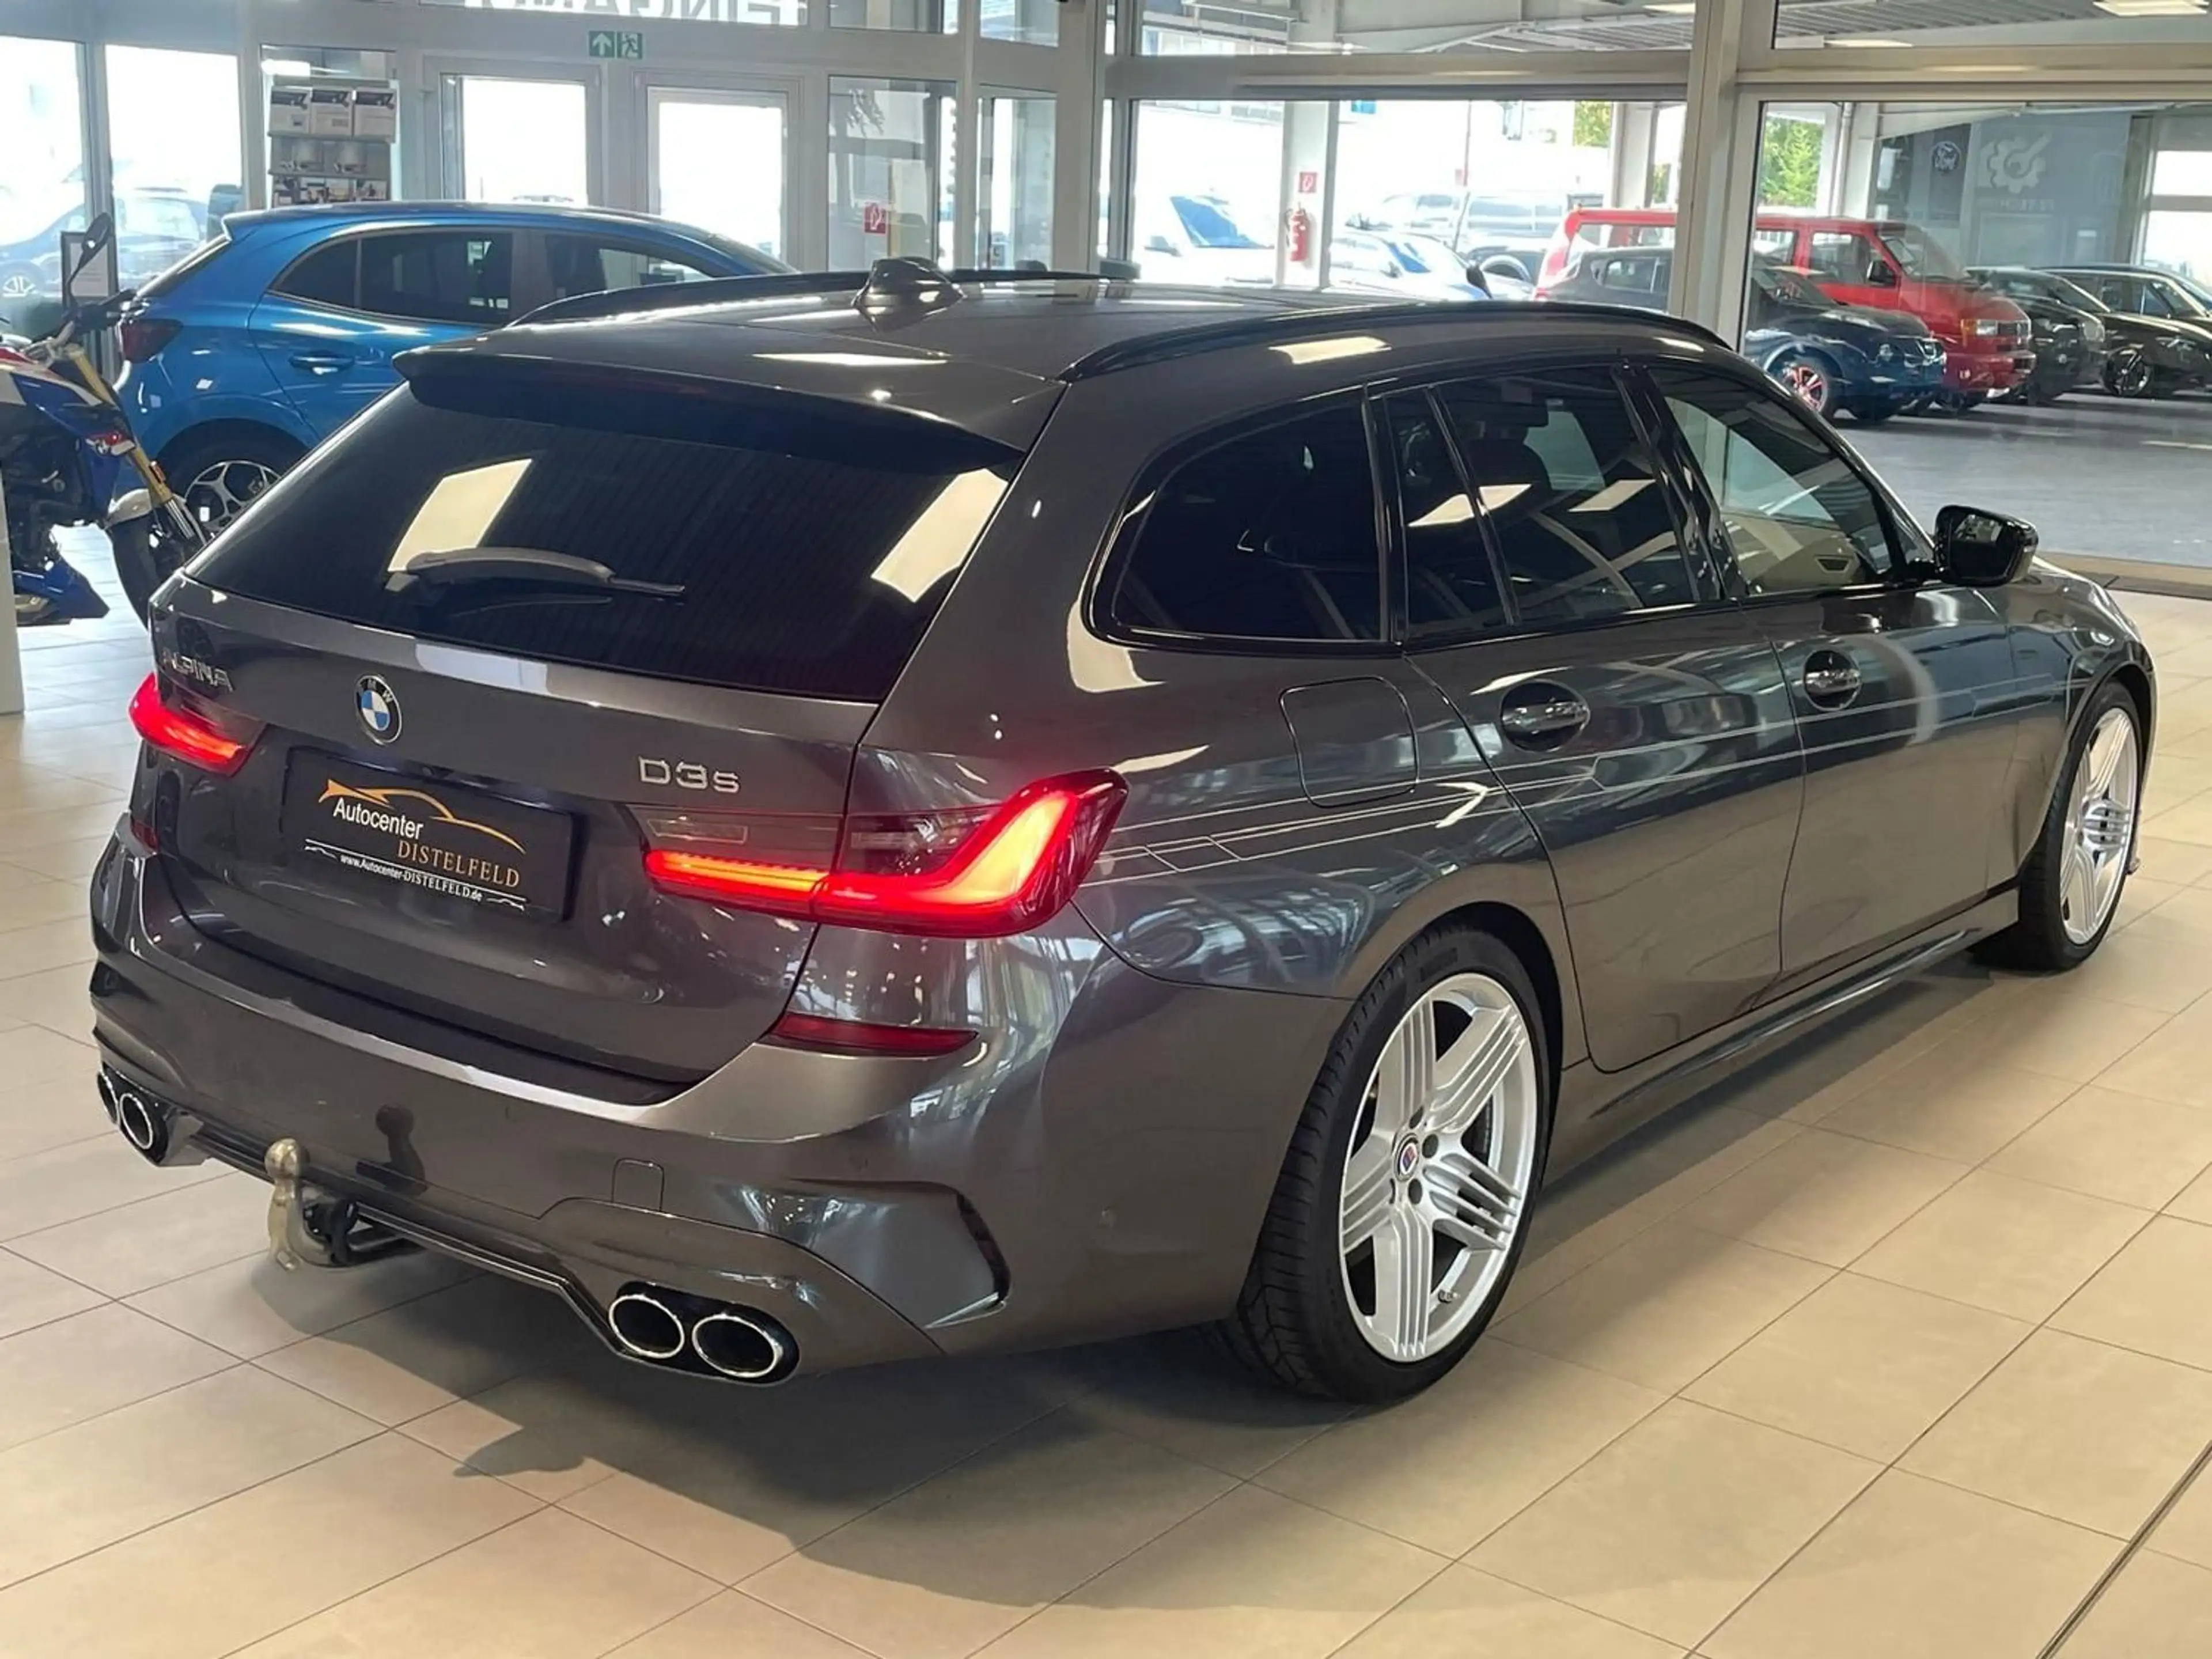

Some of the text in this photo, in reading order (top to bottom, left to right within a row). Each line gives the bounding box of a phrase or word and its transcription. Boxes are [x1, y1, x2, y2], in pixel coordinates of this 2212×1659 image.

[334, 799, 424, 839] Autocenter
[340, 855, 483, 902] www.Autocenter-DISTELFELD.de
[397, 841, 520, 888] DISTELFELD
